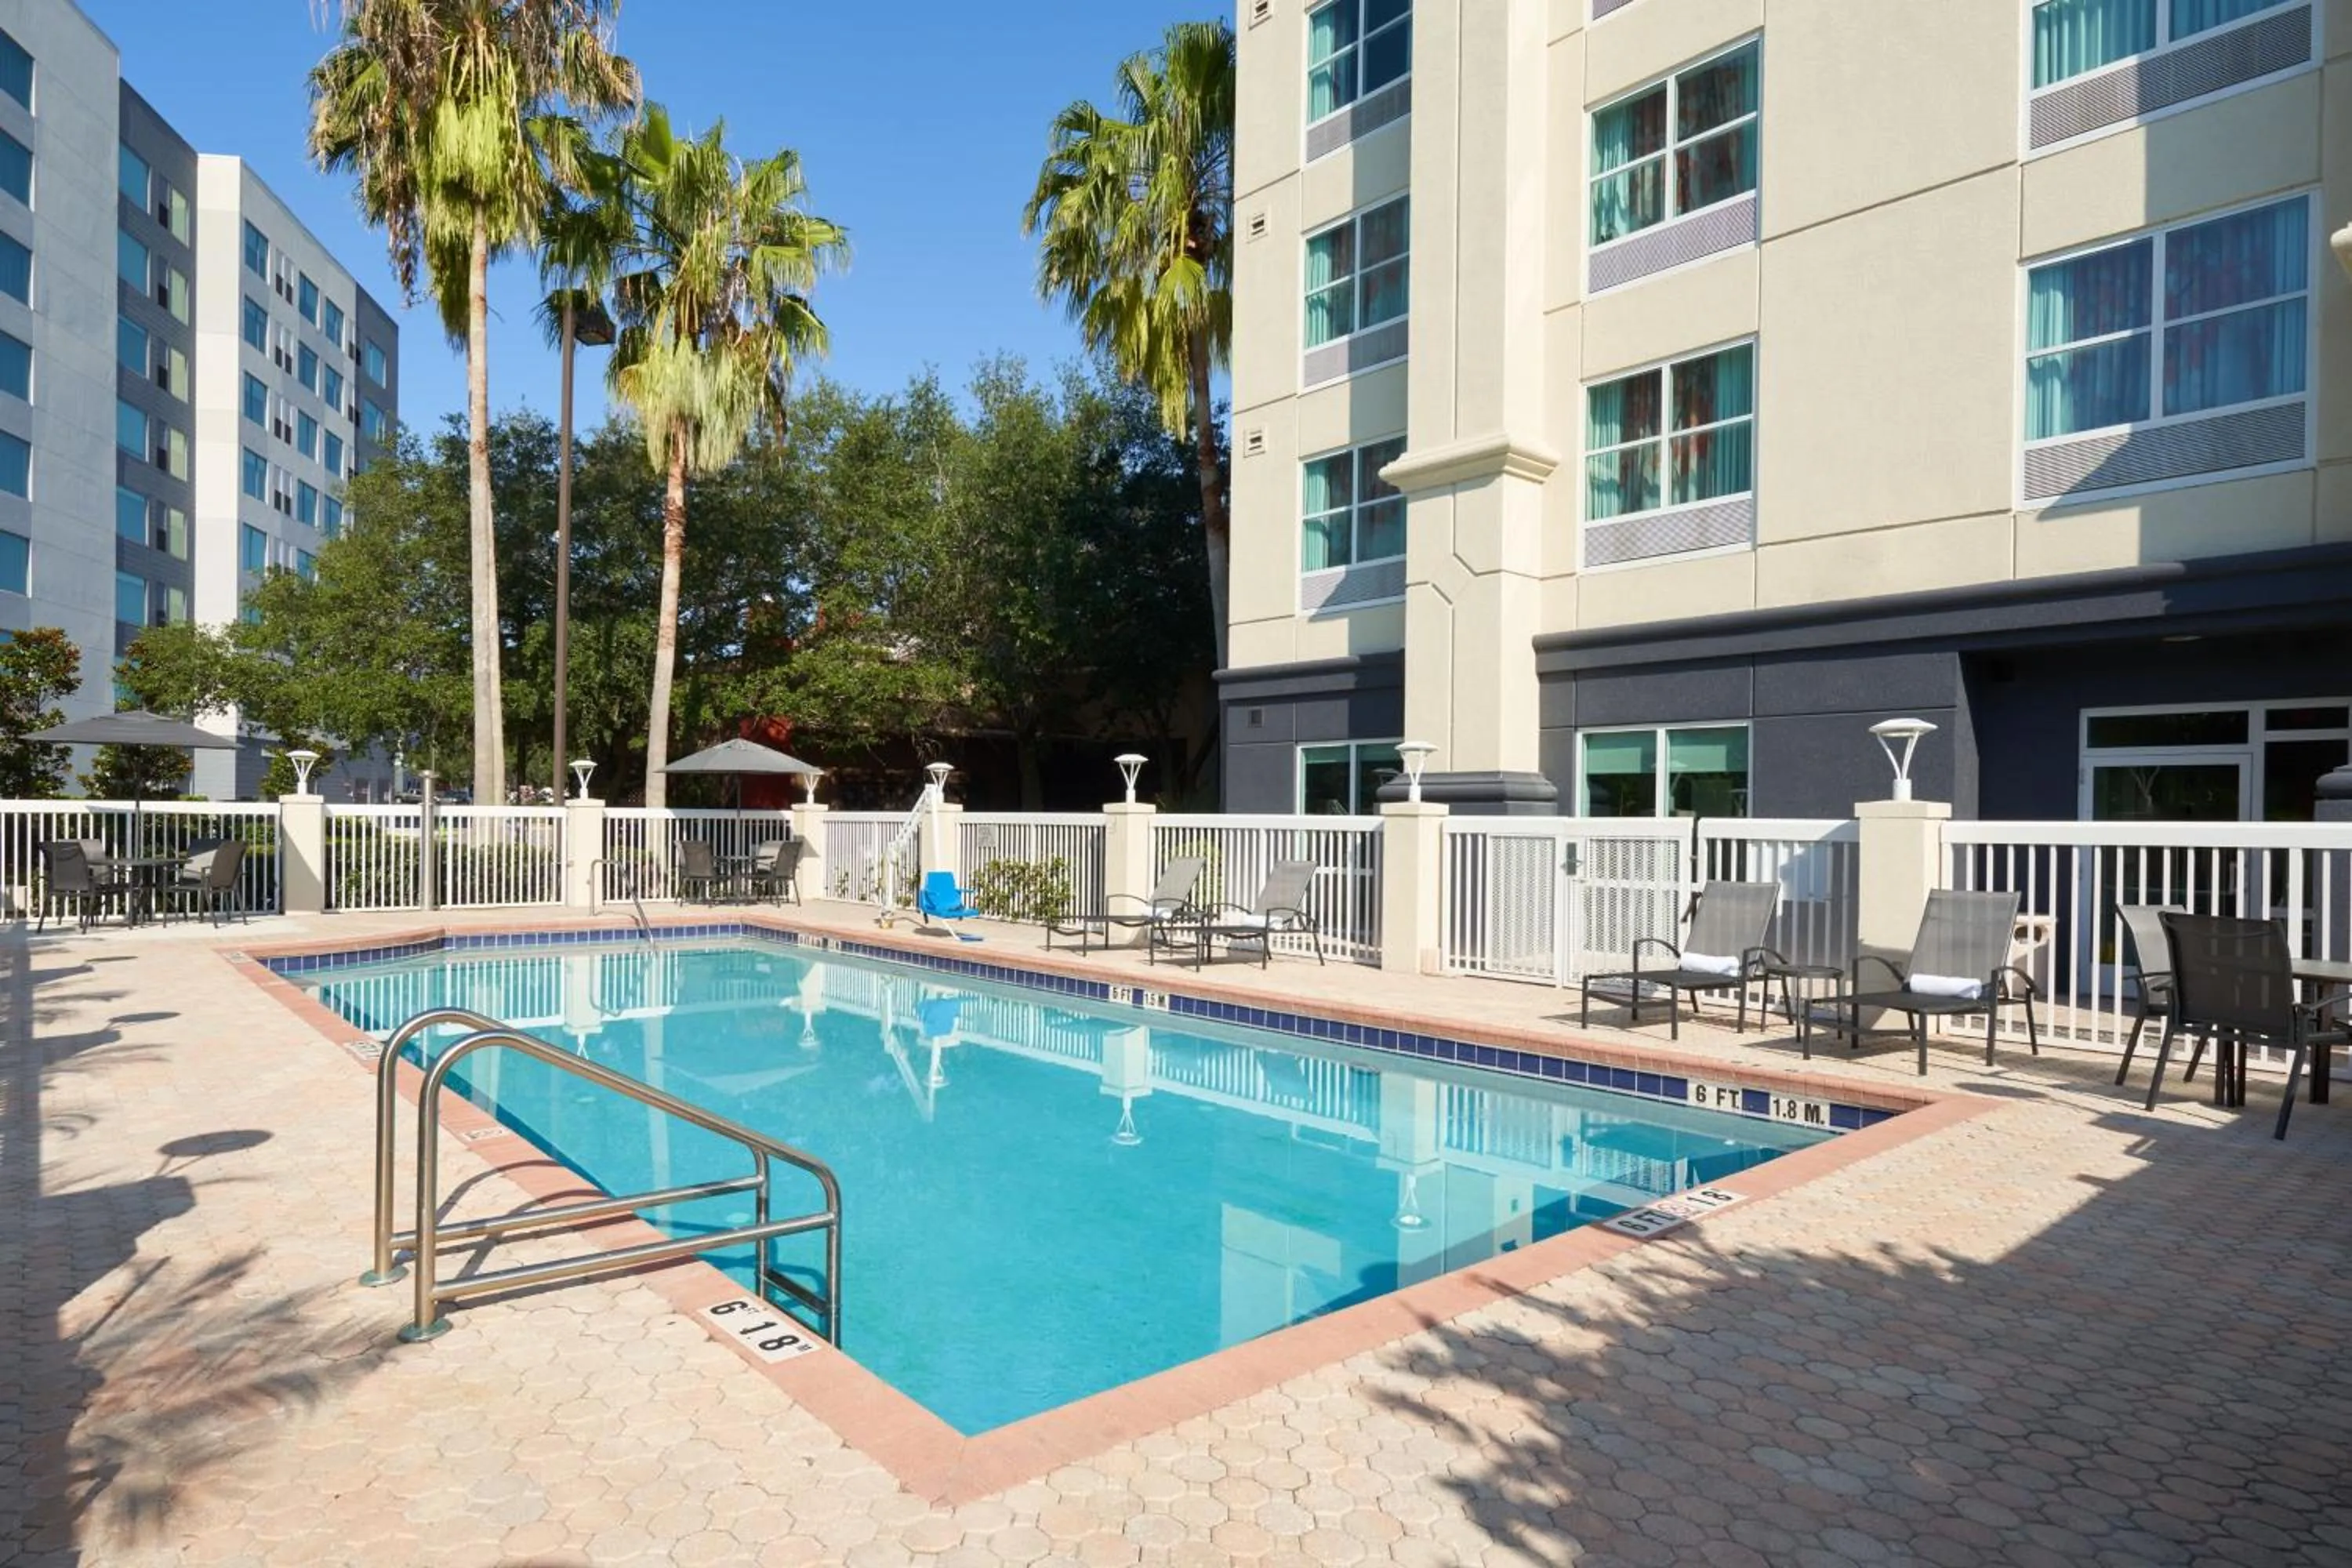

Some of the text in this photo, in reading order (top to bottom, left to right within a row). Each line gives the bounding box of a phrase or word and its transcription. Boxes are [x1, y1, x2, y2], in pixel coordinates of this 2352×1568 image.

[1695, 1084, 1707, 1103] 6
[1773, 1098, 1797, 1120] 1.8
[710, 1300, 749, 1315] 6
